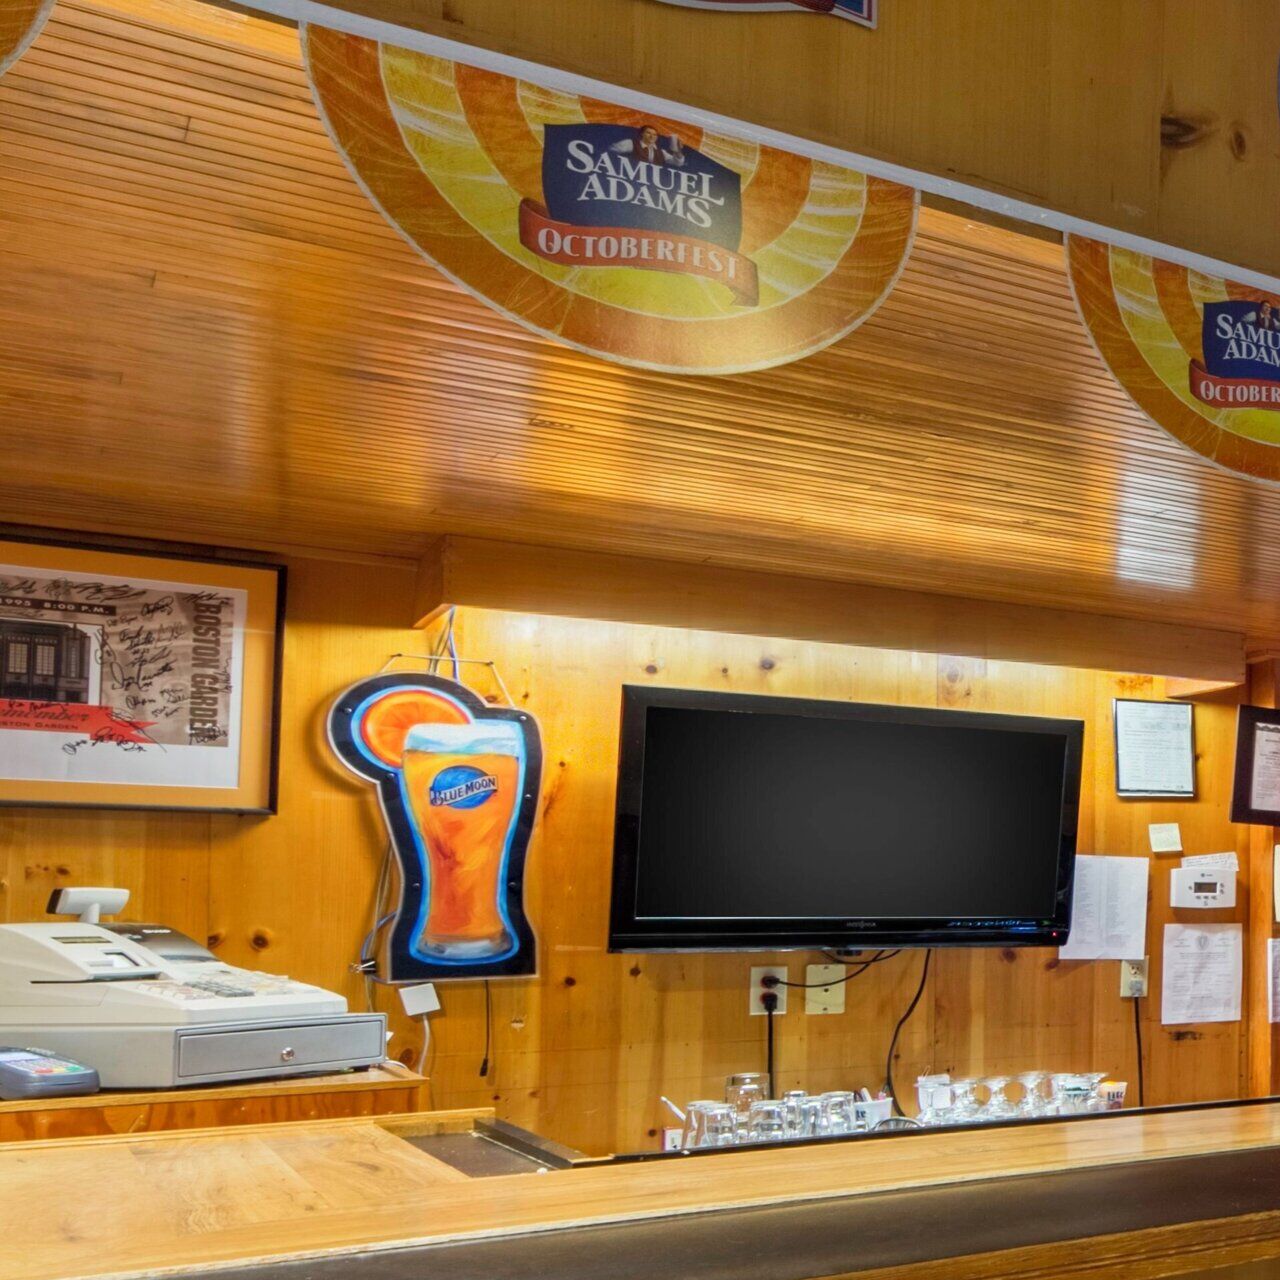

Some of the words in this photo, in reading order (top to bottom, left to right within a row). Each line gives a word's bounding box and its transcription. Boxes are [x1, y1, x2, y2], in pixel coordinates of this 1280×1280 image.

[566, 139, 725, 206] SAMUEL
[577, 174, 712, 228] ADAMS
[537, 227, 739, 279] OCTOBERFEST
[43, 601, 76, 611] 8:00
[81, 605, 110, 615] P.M.
[191, 601, 222, 670] BOSTON
[430, 787, 464, 807] BLUE
[464, 777, 496, 795] MOON
